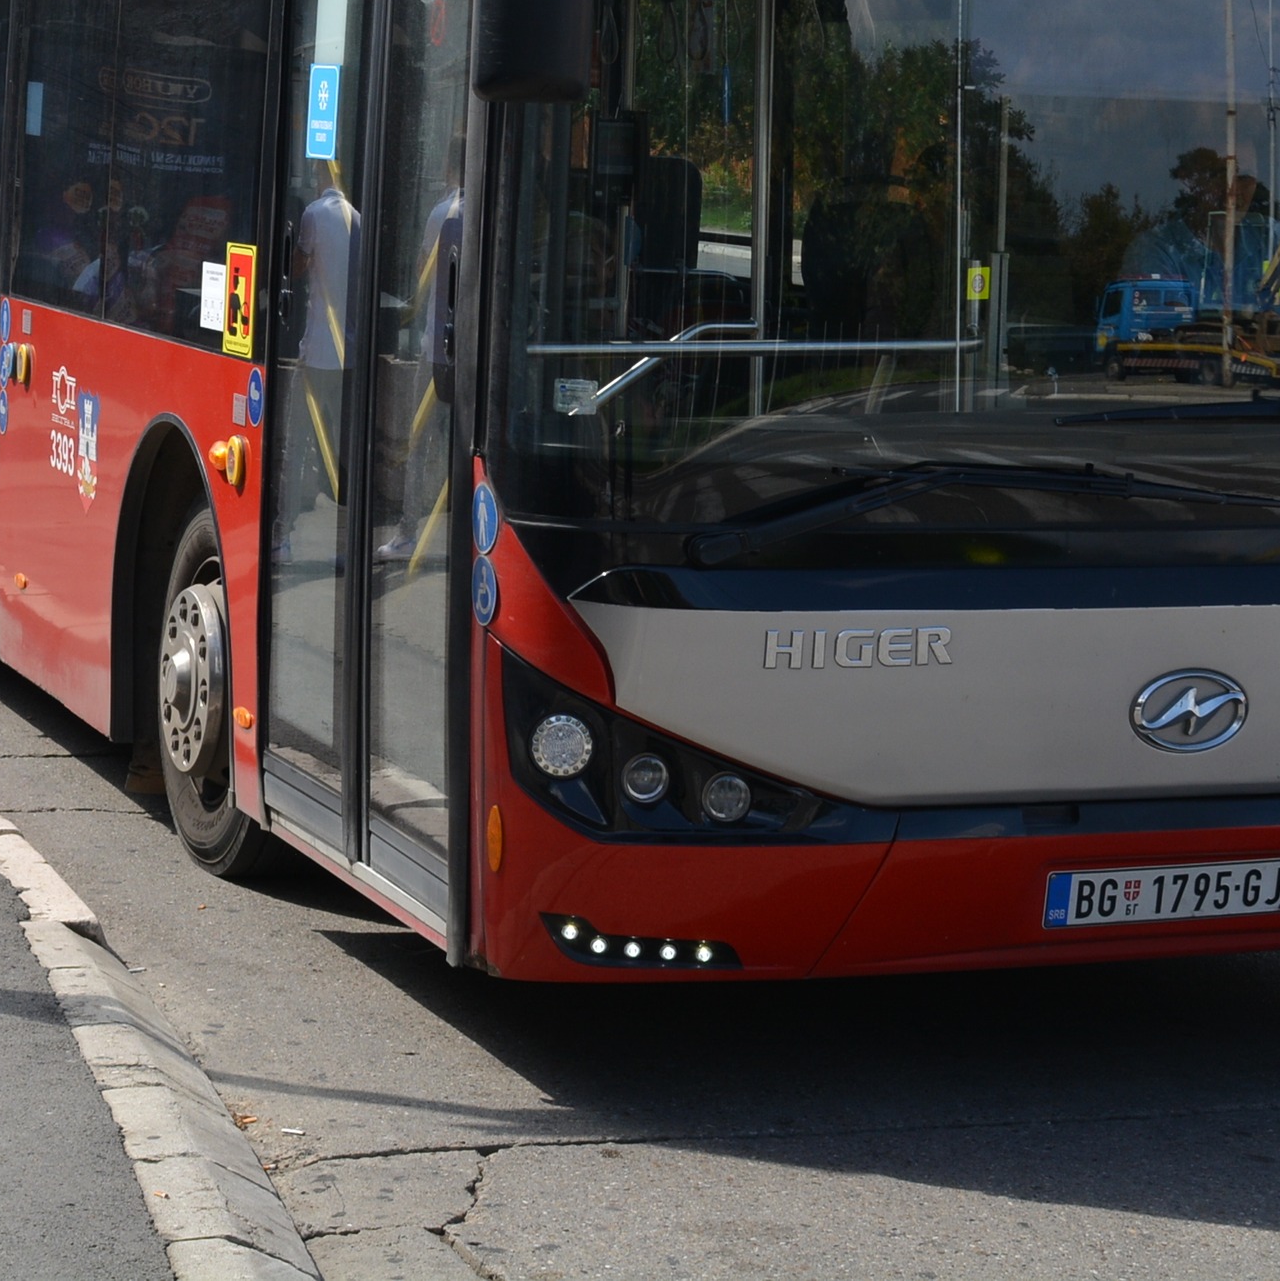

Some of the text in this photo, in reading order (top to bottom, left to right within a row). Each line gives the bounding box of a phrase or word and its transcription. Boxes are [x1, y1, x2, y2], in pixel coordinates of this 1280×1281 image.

[50, 430, 75, 476] 3393
[764, 626, 952, 669] HIGER
[1048, 909, 1066, 920] SRB
[1075, 879, 1118, 919] BG
